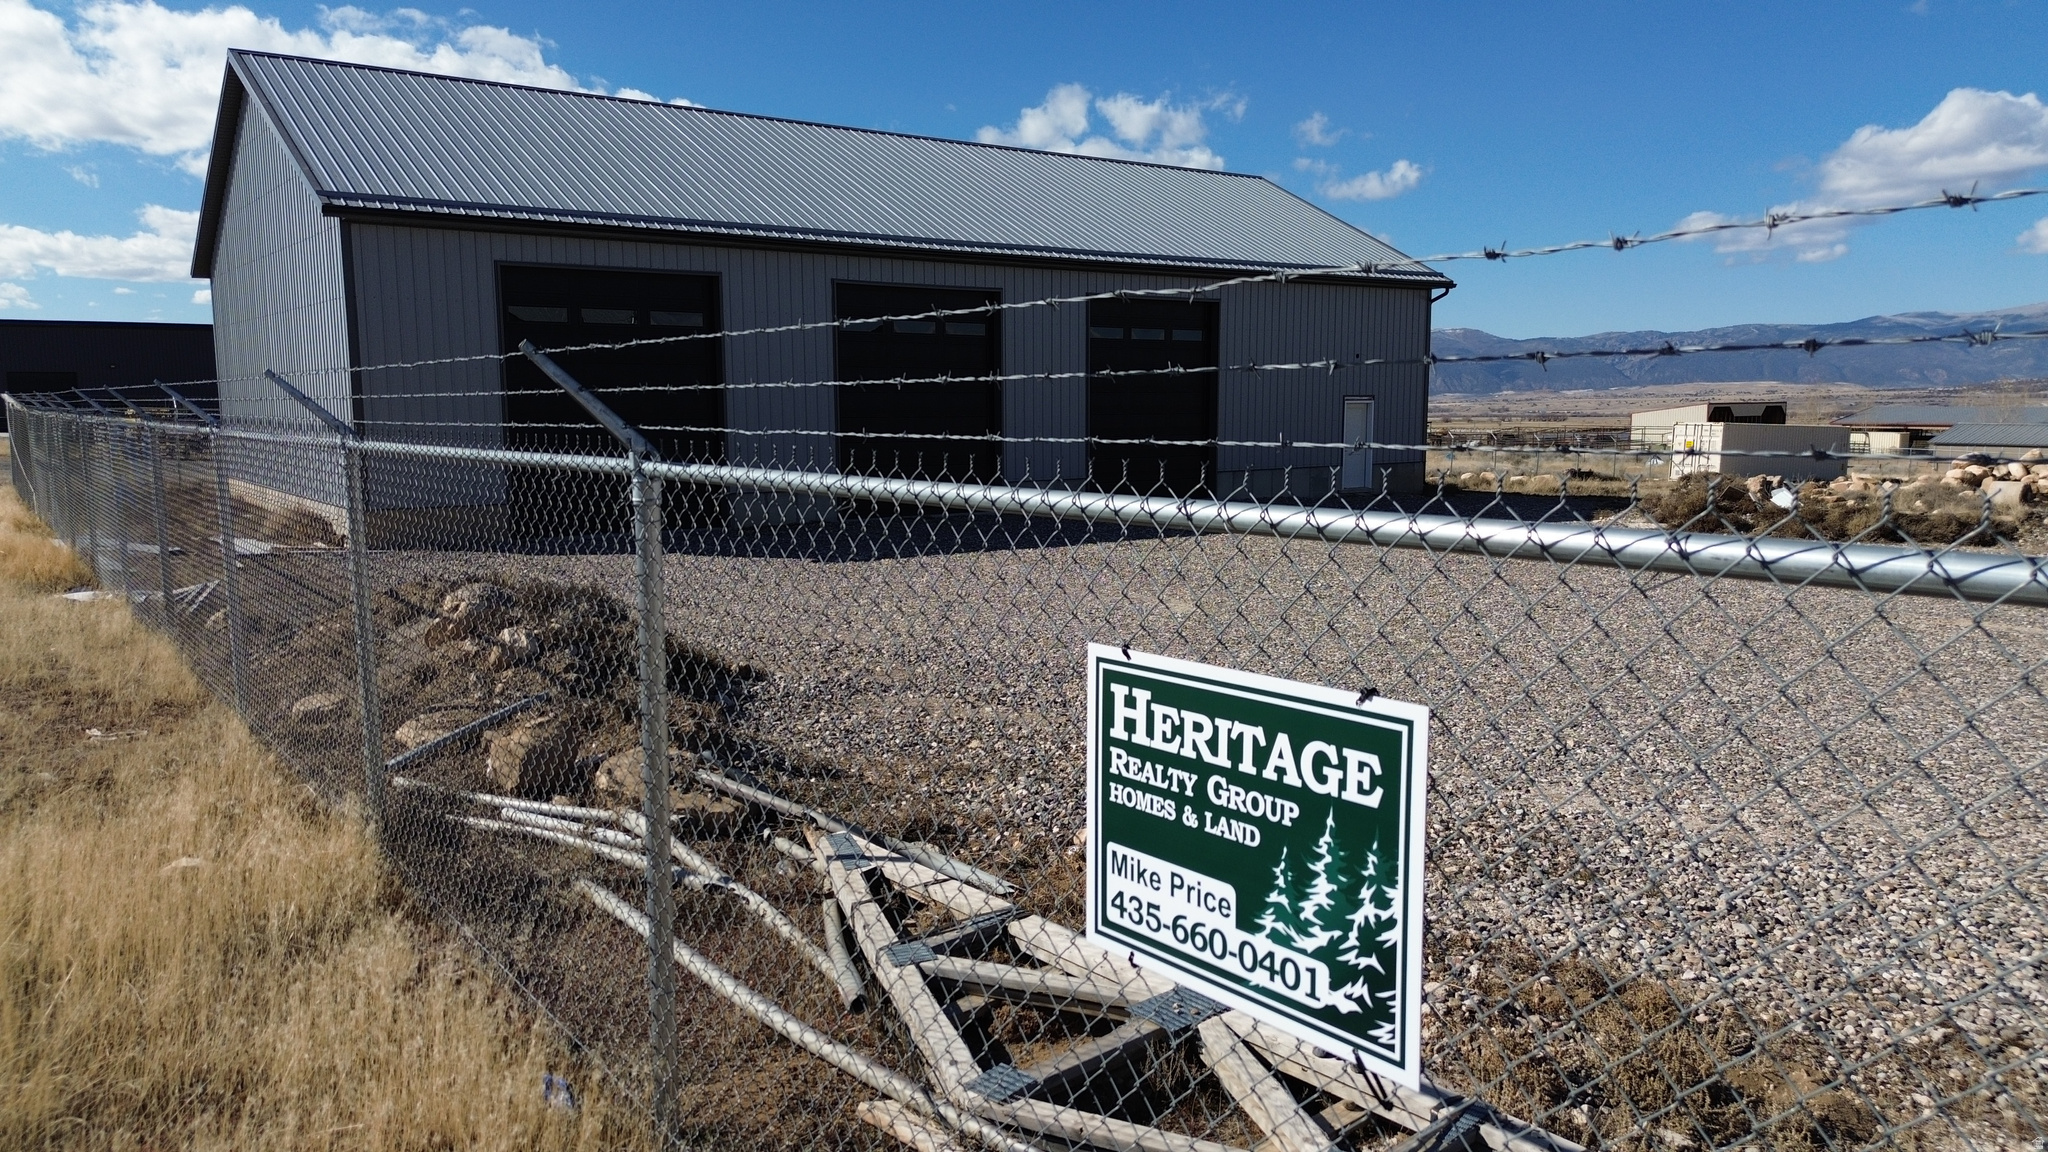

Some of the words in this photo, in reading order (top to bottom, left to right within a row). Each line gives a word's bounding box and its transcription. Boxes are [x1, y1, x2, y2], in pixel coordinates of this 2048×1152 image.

[1109, 746, 1198, 797] REALTY
[1206, 775, 1300, 827] GROUP
[1110, 683, 1384, 809] HERITAGE
[1109, 782, 1177, 821] HOMES
[1182, 805, 1199, 829] &
[1204, 811, 1261, 848] LAND
[1111, 850, 1162, 891] Mike
[1170, 871, 1232, 919] Price
[1110, 890, 1322, 1002] 435-660-0401
